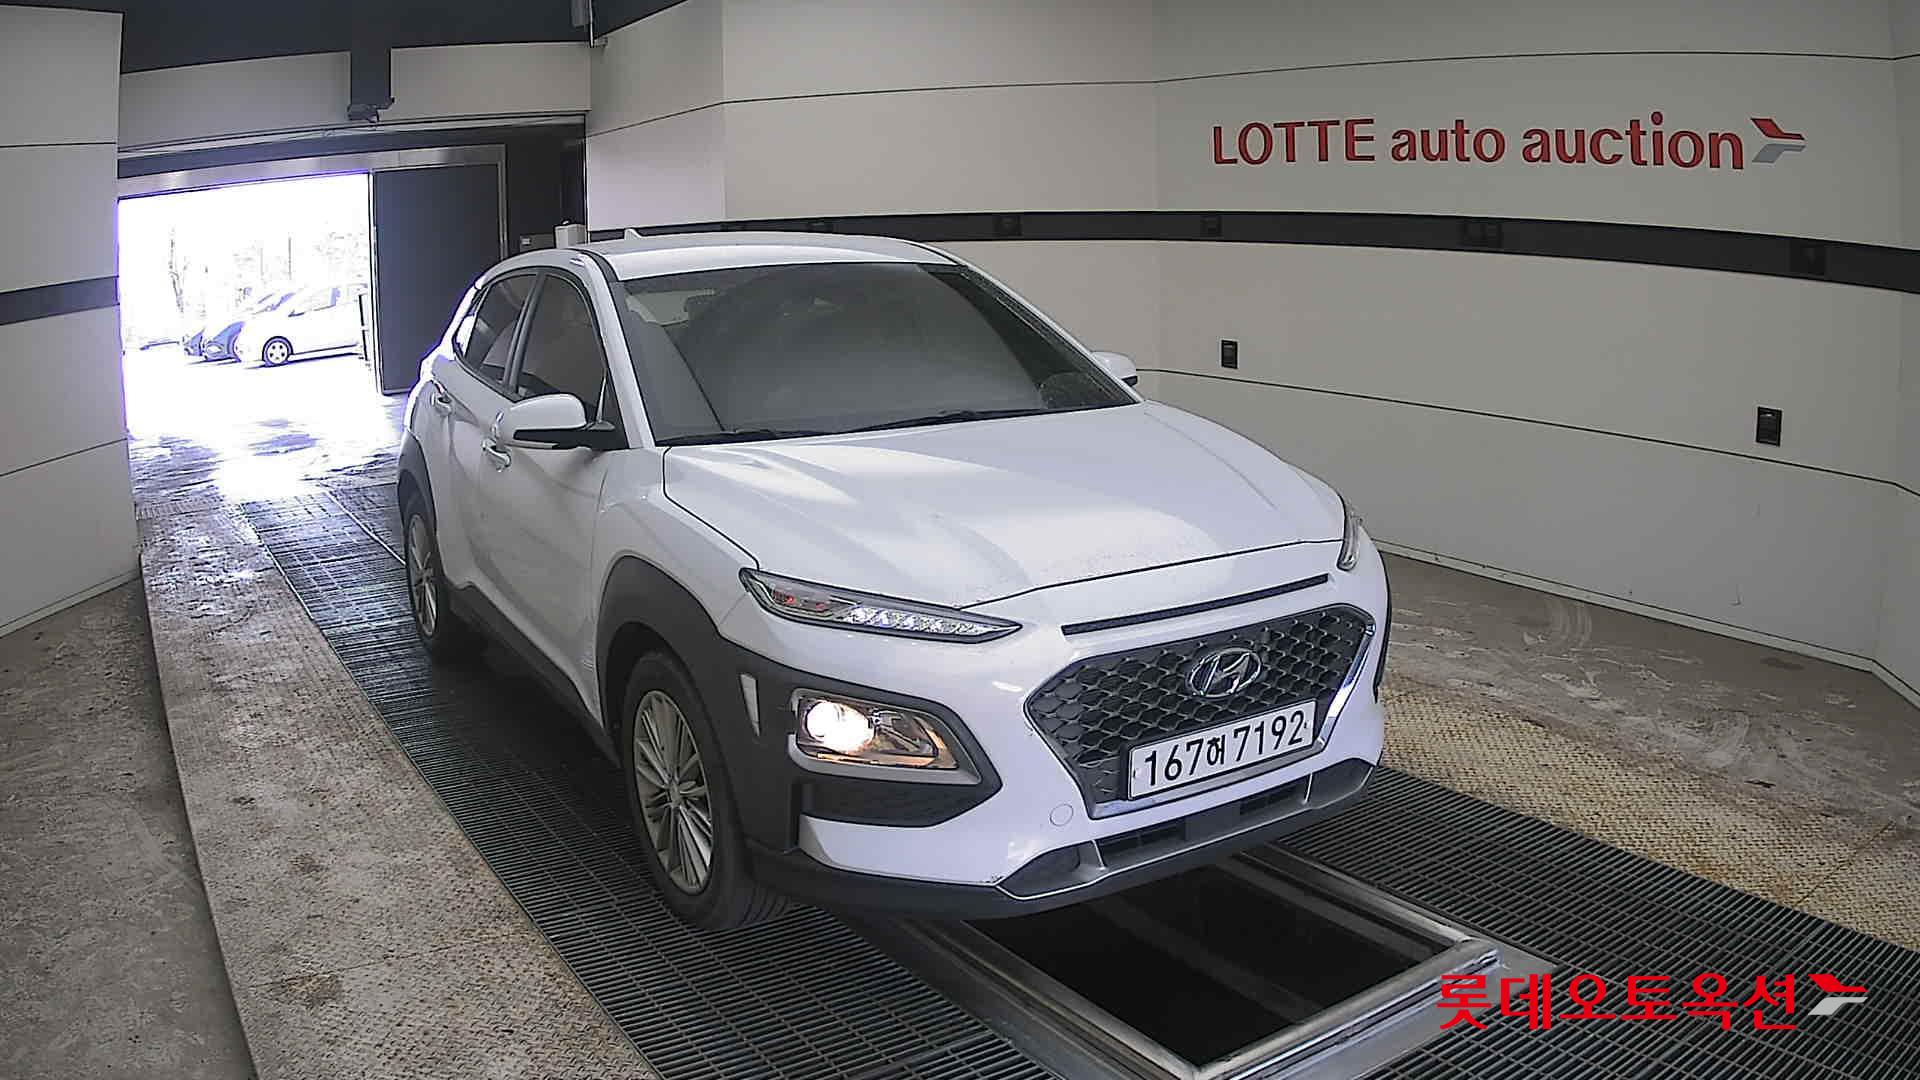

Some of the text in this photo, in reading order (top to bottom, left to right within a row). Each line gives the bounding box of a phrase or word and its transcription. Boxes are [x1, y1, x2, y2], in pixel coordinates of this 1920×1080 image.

[1213, 111, 1744, 170] LOTTE auto auction
[1233, 711, 1304, 762] 7192
